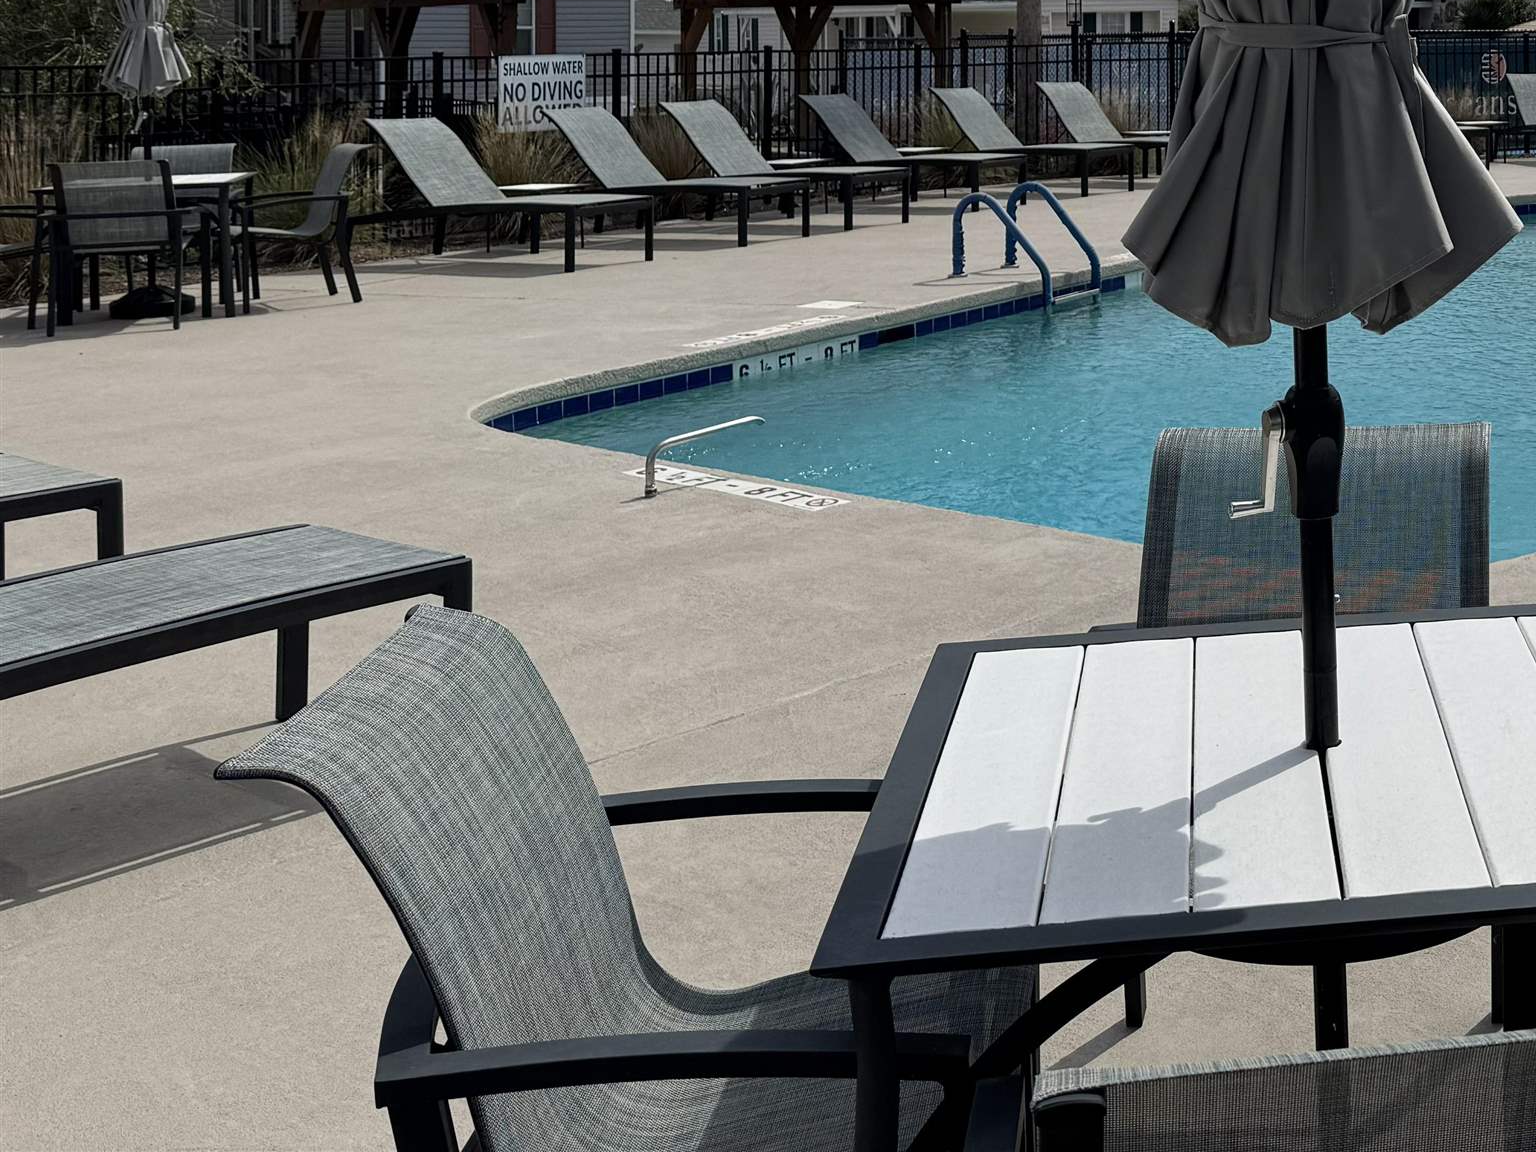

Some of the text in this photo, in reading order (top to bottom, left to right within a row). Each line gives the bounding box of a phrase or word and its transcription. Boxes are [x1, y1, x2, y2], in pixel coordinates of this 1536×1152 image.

[503, 60, 583, 76] SHALLOW WATER
[503, 80, 583, 103] NO DIVING
[502, 103, 583, 127] ALLO
[778, 352, 796, 368] FT
